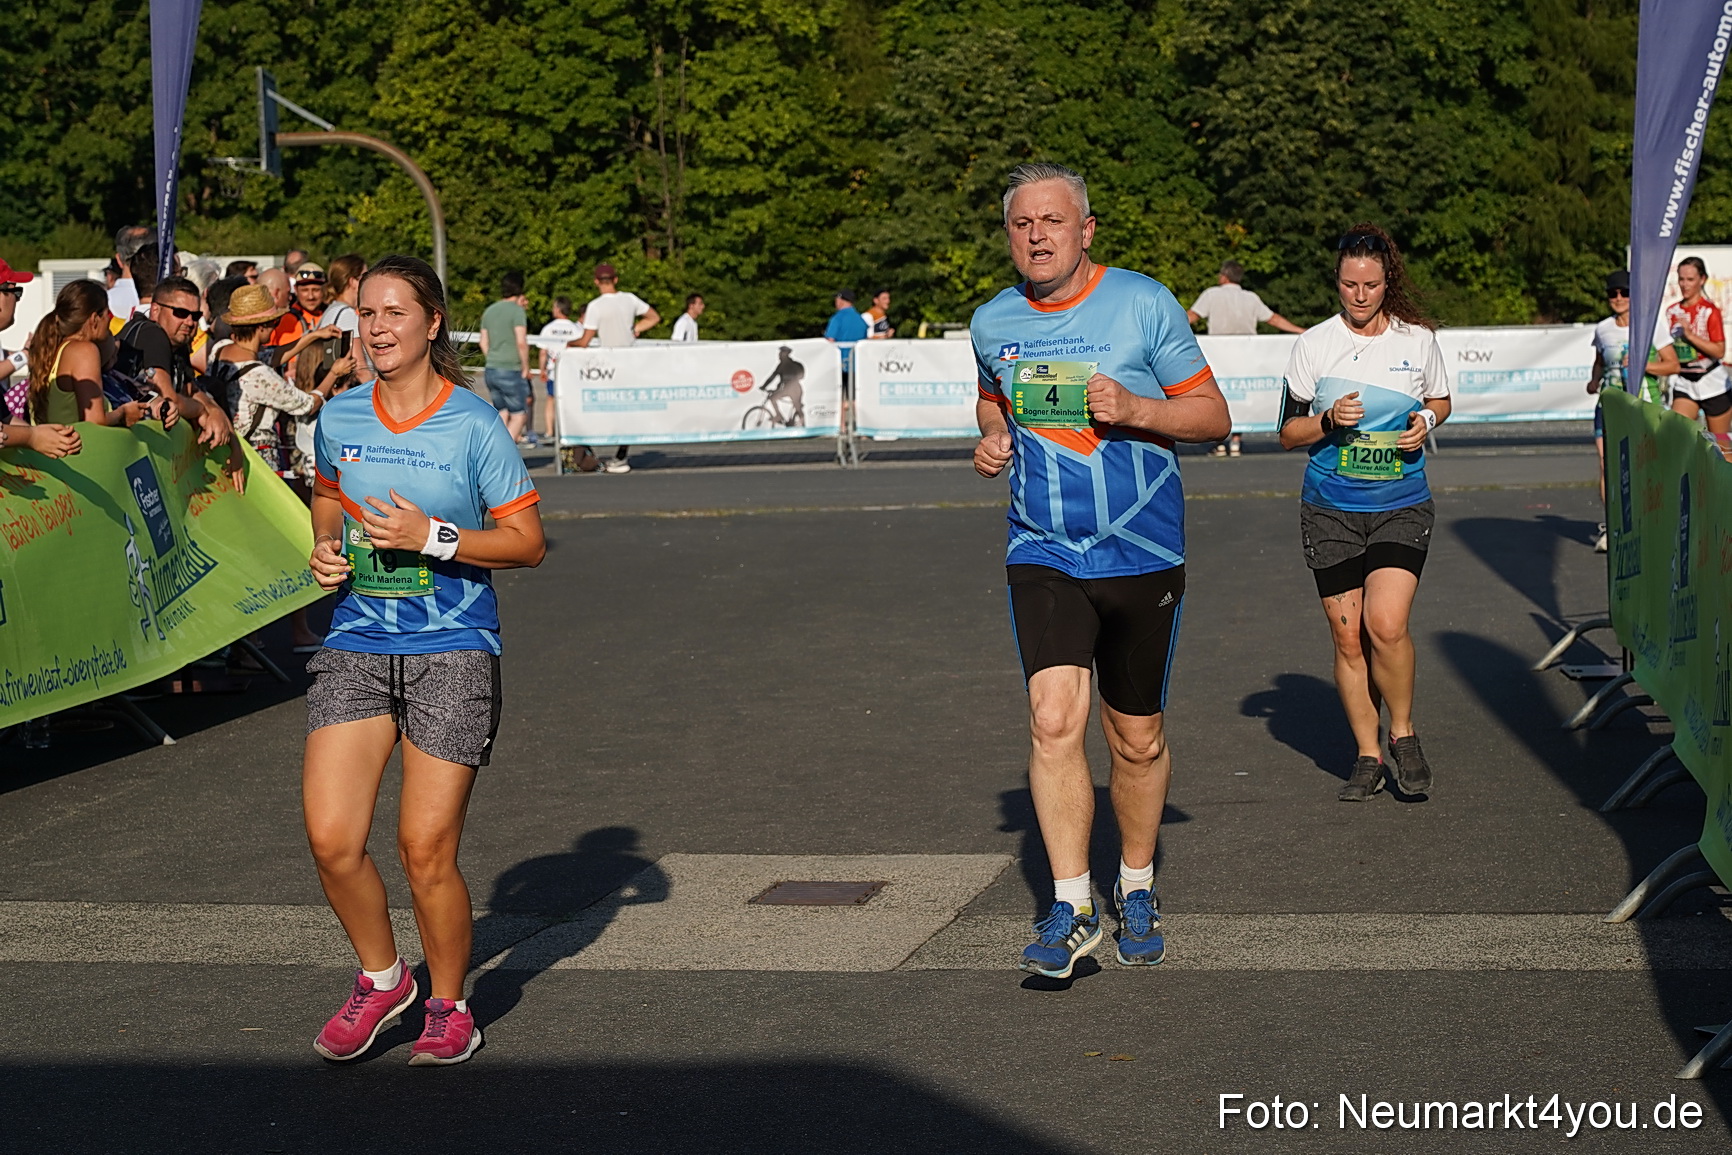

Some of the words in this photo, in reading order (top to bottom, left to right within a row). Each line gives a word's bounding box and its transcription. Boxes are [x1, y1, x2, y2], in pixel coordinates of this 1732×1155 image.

[1024, 336, 1085, 349] Raiffeisenbank
[1023, 348, 1064, 359] Neumarkt
[1099, 343, 1111, 353] eG
[1458, 350, 1493, 363] NOW
[879, 360, 914, 373] NOW
[579, 368, 615, 381] NOW
[1045, 384, 1060, 407] 4
[1016, 391, 1024, 415] RUN
[1023, 408, 1049, 417] Bogner
[1051, 408, 1084, 416] Reinhold
[366, 445, 426, 459] Raiffeisenbank
[1341, 449, 1349, 467] RUN
[1350, 446, 1394, 464] 1200
[365, 455, 405, 466] Neumarkt
[439, 463, 451, 472] eG
[1352, 463, 1373, 471] Laurer
[368, 550, 397, 574] 19
[359, 573, 375, 583] Pirkl
[377, 575, 413, 584] Marlena
